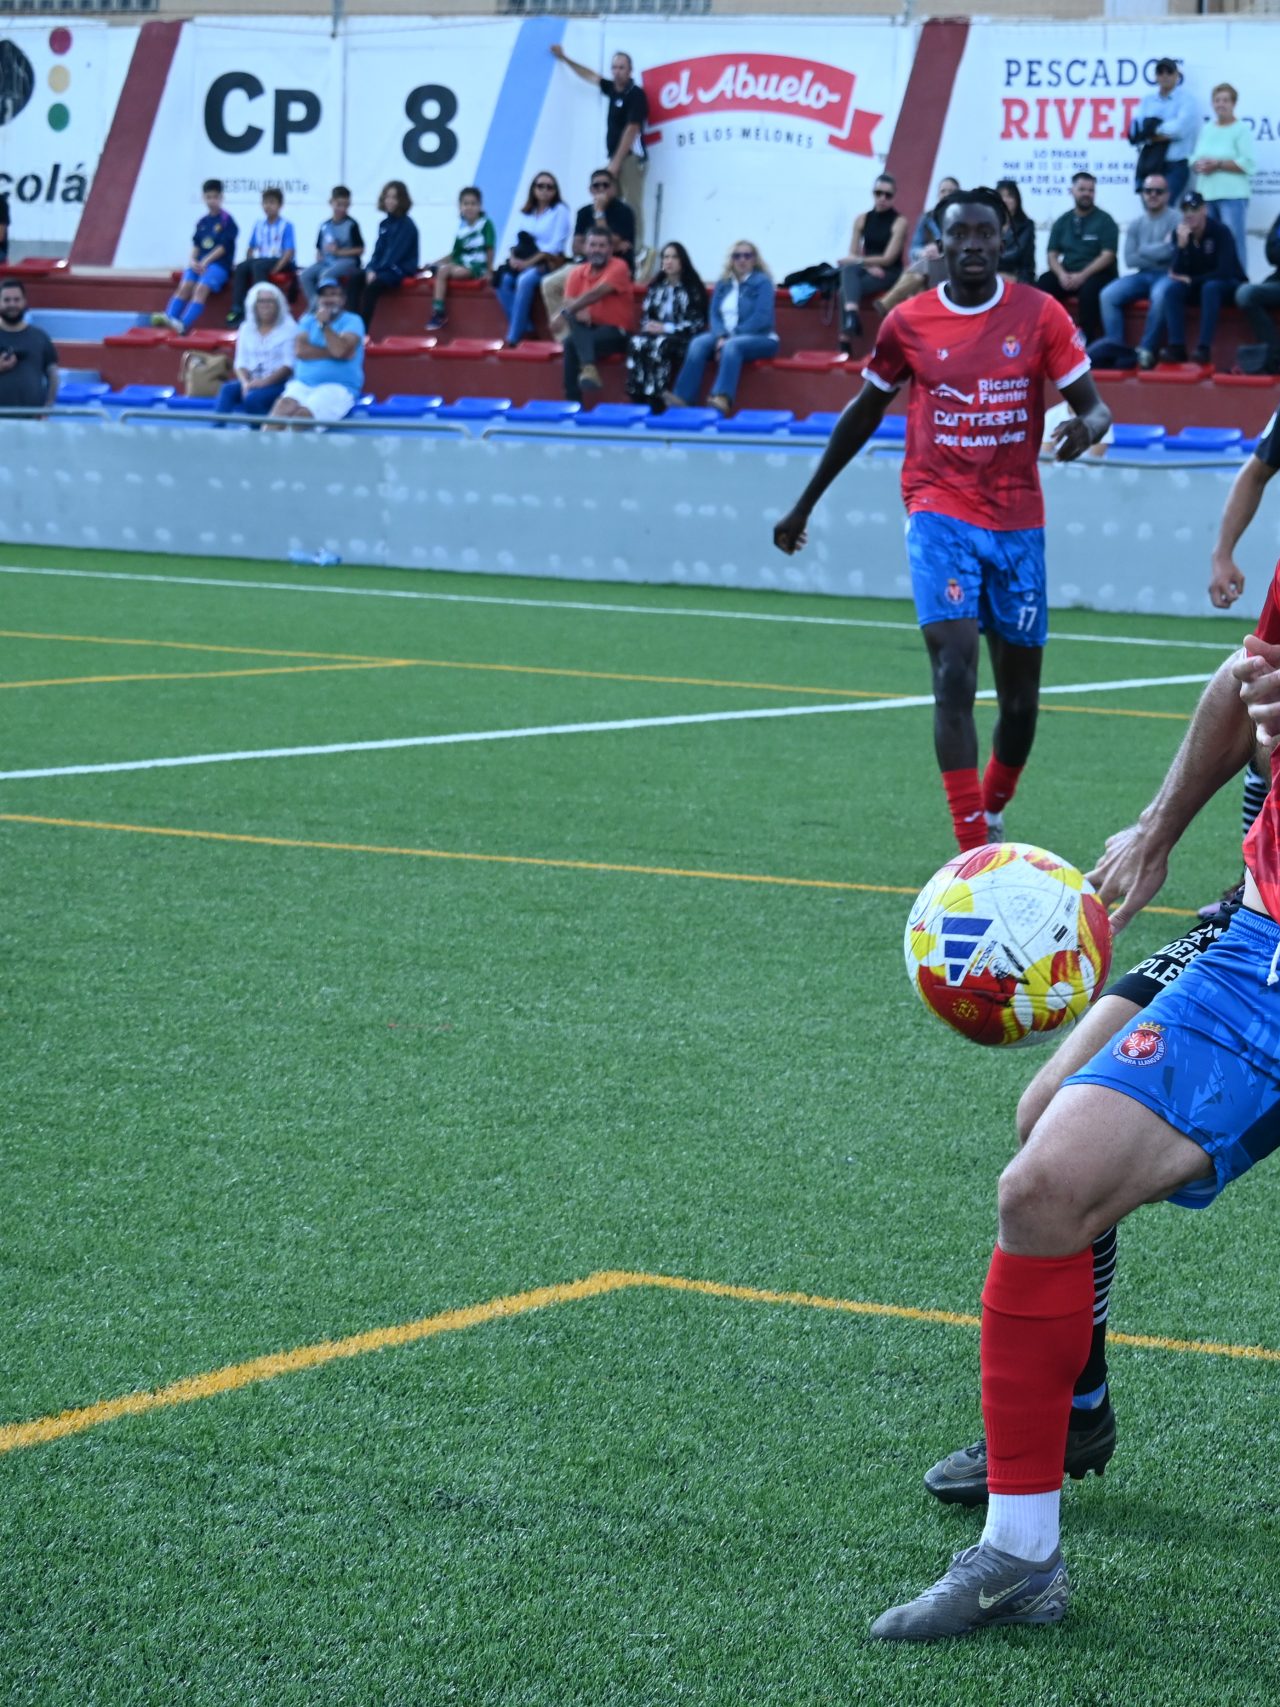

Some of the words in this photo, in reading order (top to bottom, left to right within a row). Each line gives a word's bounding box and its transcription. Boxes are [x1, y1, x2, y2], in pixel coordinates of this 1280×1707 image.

[660, 69, 694, 110] el
[697, 62, 842, 110] Abuelo
[402, 84, 459, 168] 8
[677, 130, 696, 148] DE
[704, 127, 733, 144] LOS
[740, 126, 814, 149] MELONES
[977, 377, 1031, 392] Ricardo
[960, 434, 998, 447] BLAYA
[1017, 606, 1037, 632] 17
